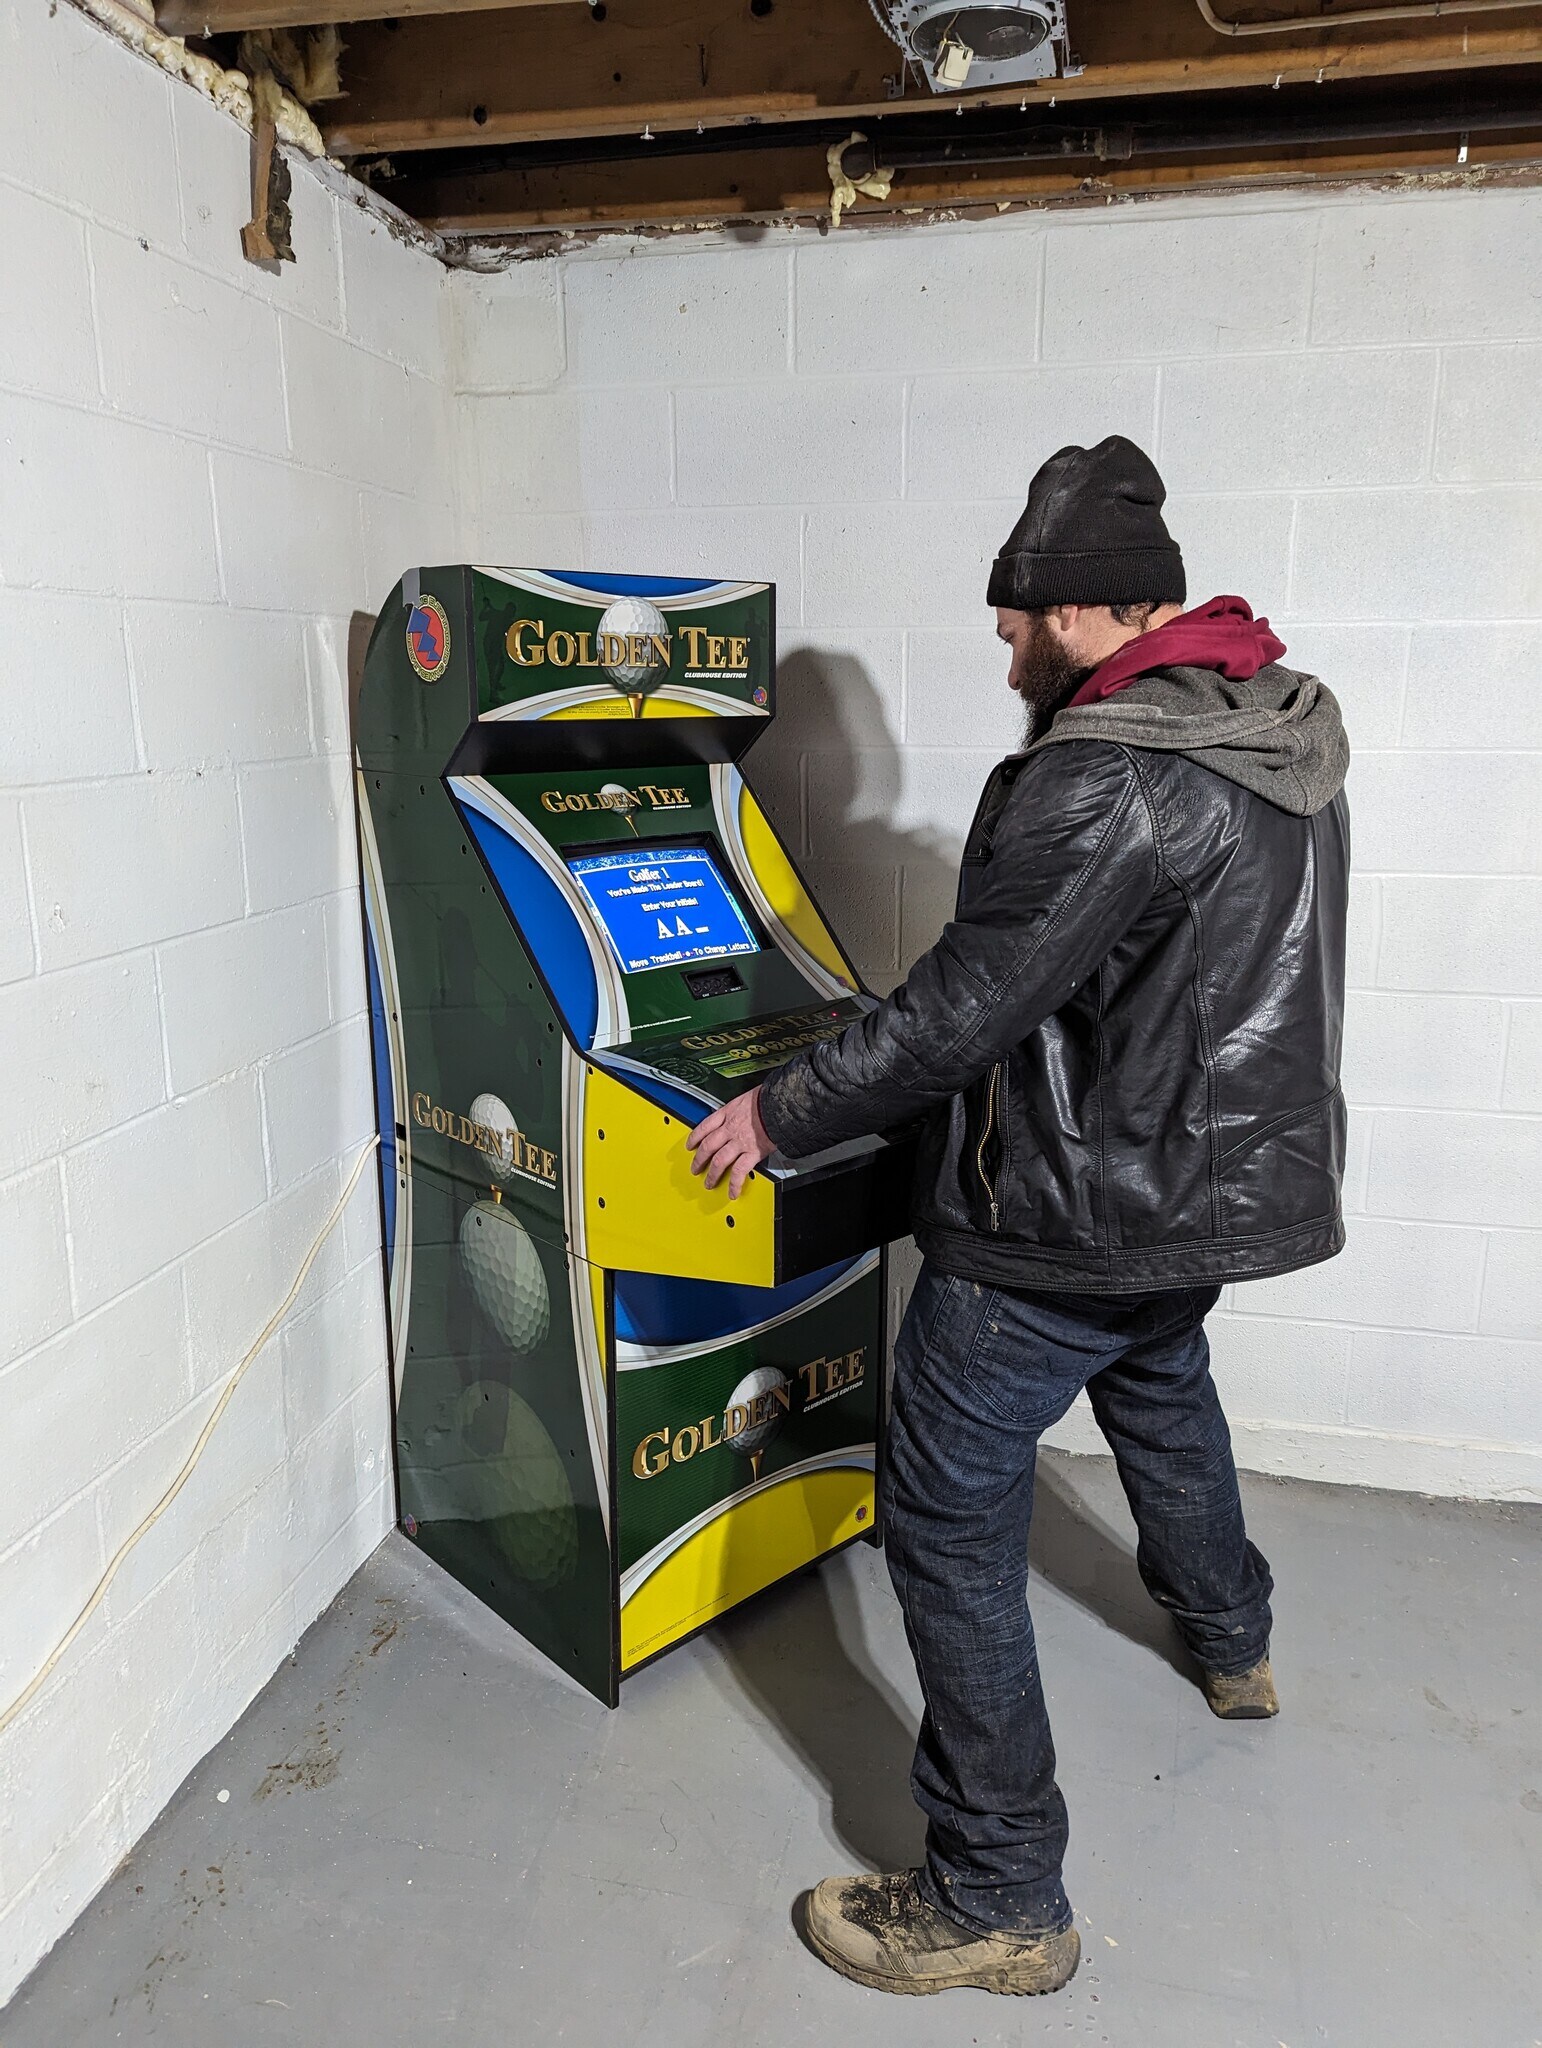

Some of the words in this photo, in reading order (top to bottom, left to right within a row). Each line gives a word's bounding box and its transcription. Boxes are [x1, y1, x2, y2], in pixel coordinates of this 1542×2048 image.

[505, 619, 673, 667] GOLDEN
[678, 626, 749, 669] TEE
[540, 790, 643, 813] GOLDEN
[638, 785, 690, 806] TEE
[628, 868, 661, 883] Golfer
[660, 866, 671, 880] 1
[629, 885, 650, 894] Made
[647, 883, 662, 892] The
[660, 881, 683, 890] Leader
[641, 902, 661, 912] Enter
[659, 900, 677, 909] Your
[629, 959, 649, 969] Move
[650, 952, 682, 964] Trackball
[692, 948, 704, 956] To
[704, 945, 727, 954] Change
[727, 942, 751, 951] Letters
[680, 1020, 786, 1050] GOLDEN
[777, 1012, 833, 1028] TEE
[412, 1092, 504, 1160] GOLDEN
[506, 1128, 557, 1181] TEE
[510, 1167, 537, 1182] CLUBHOUSE
[536, 1178, 557, 1190] EDITION
[803, 1391, 840, 1413] CLUBHOUSE
[839, 1380, 864, 1396] EDITION
[632, 1379, 793, 1480] GOLDEN
[798, 1347, 866, 1402] TEE
